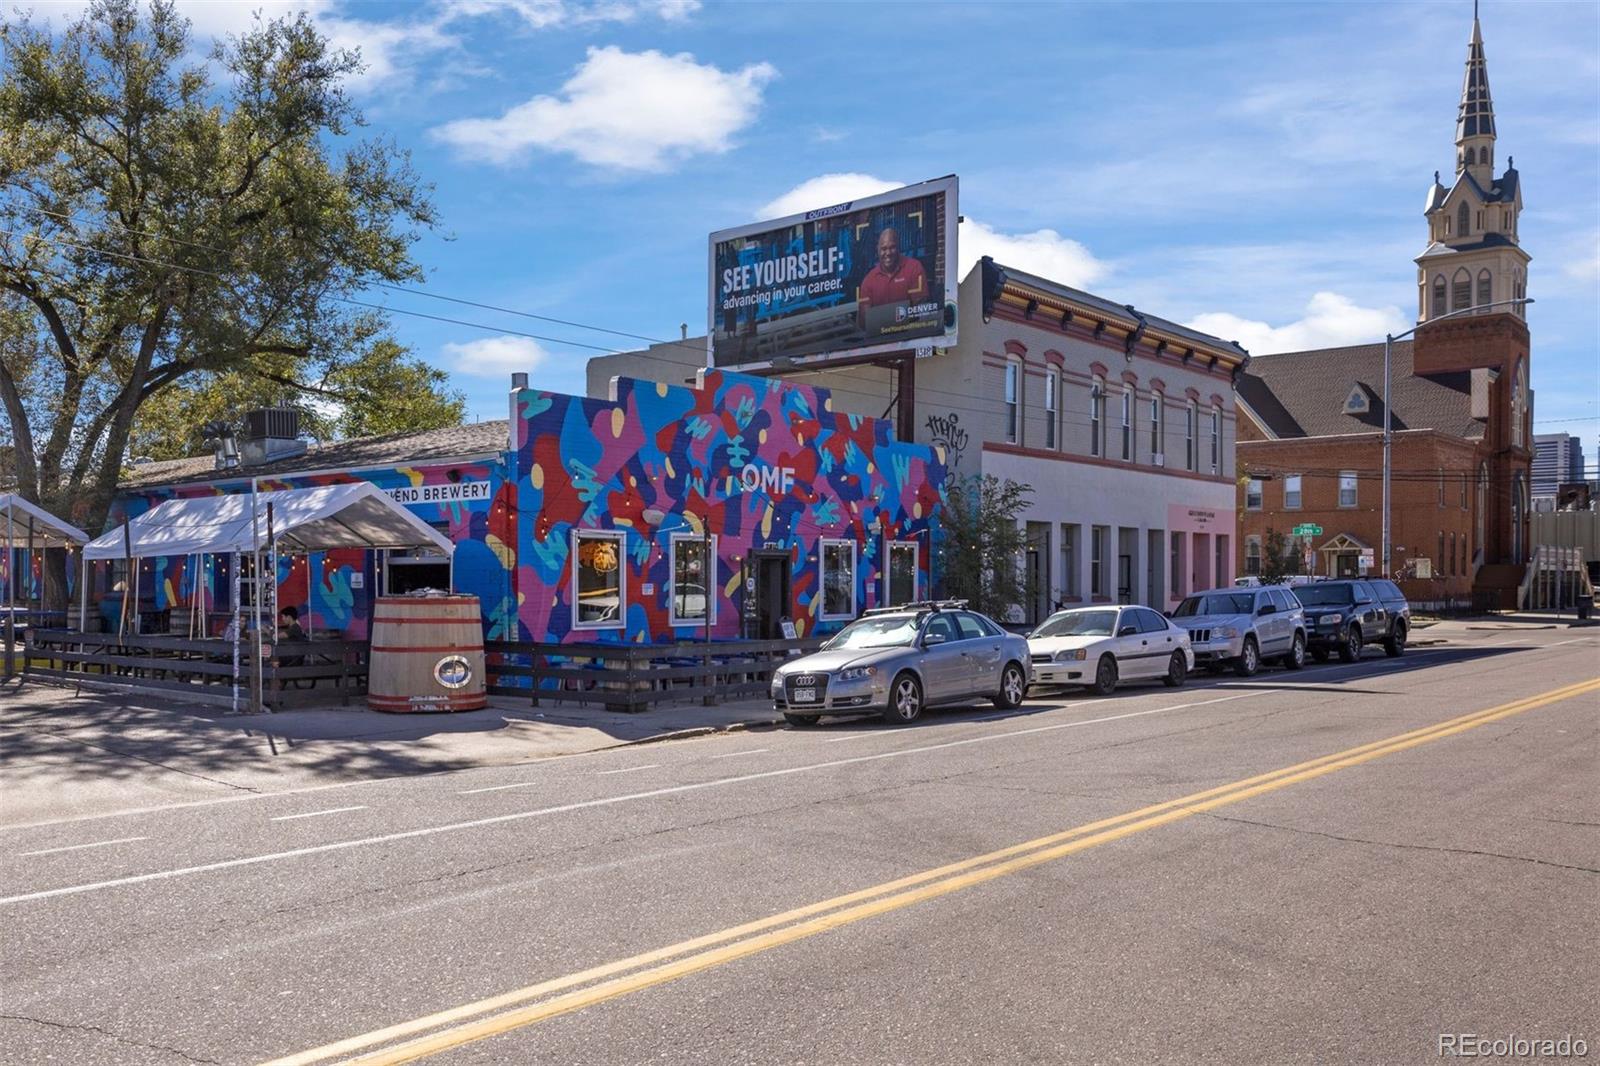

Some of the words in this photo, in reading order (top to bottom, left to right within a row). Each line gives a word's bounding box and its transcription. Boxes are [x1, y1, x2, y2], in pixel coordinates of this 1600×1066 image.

[809, 203, 850, 218] OUTFRONT
[723, 265, 751, 293] SEE
[754, 246, 844, 287] YOURSELF:
[723, 290, 771, 310] advancing
[773, 287, 783, 301] in
[784, 285, 806, 302] your
[808, 278, 843, 294] career.
[907, 303, 938, 315] DENVER
[741, 463, 796, 495] OMF
[424, 483, 489, 501] BREWERY
